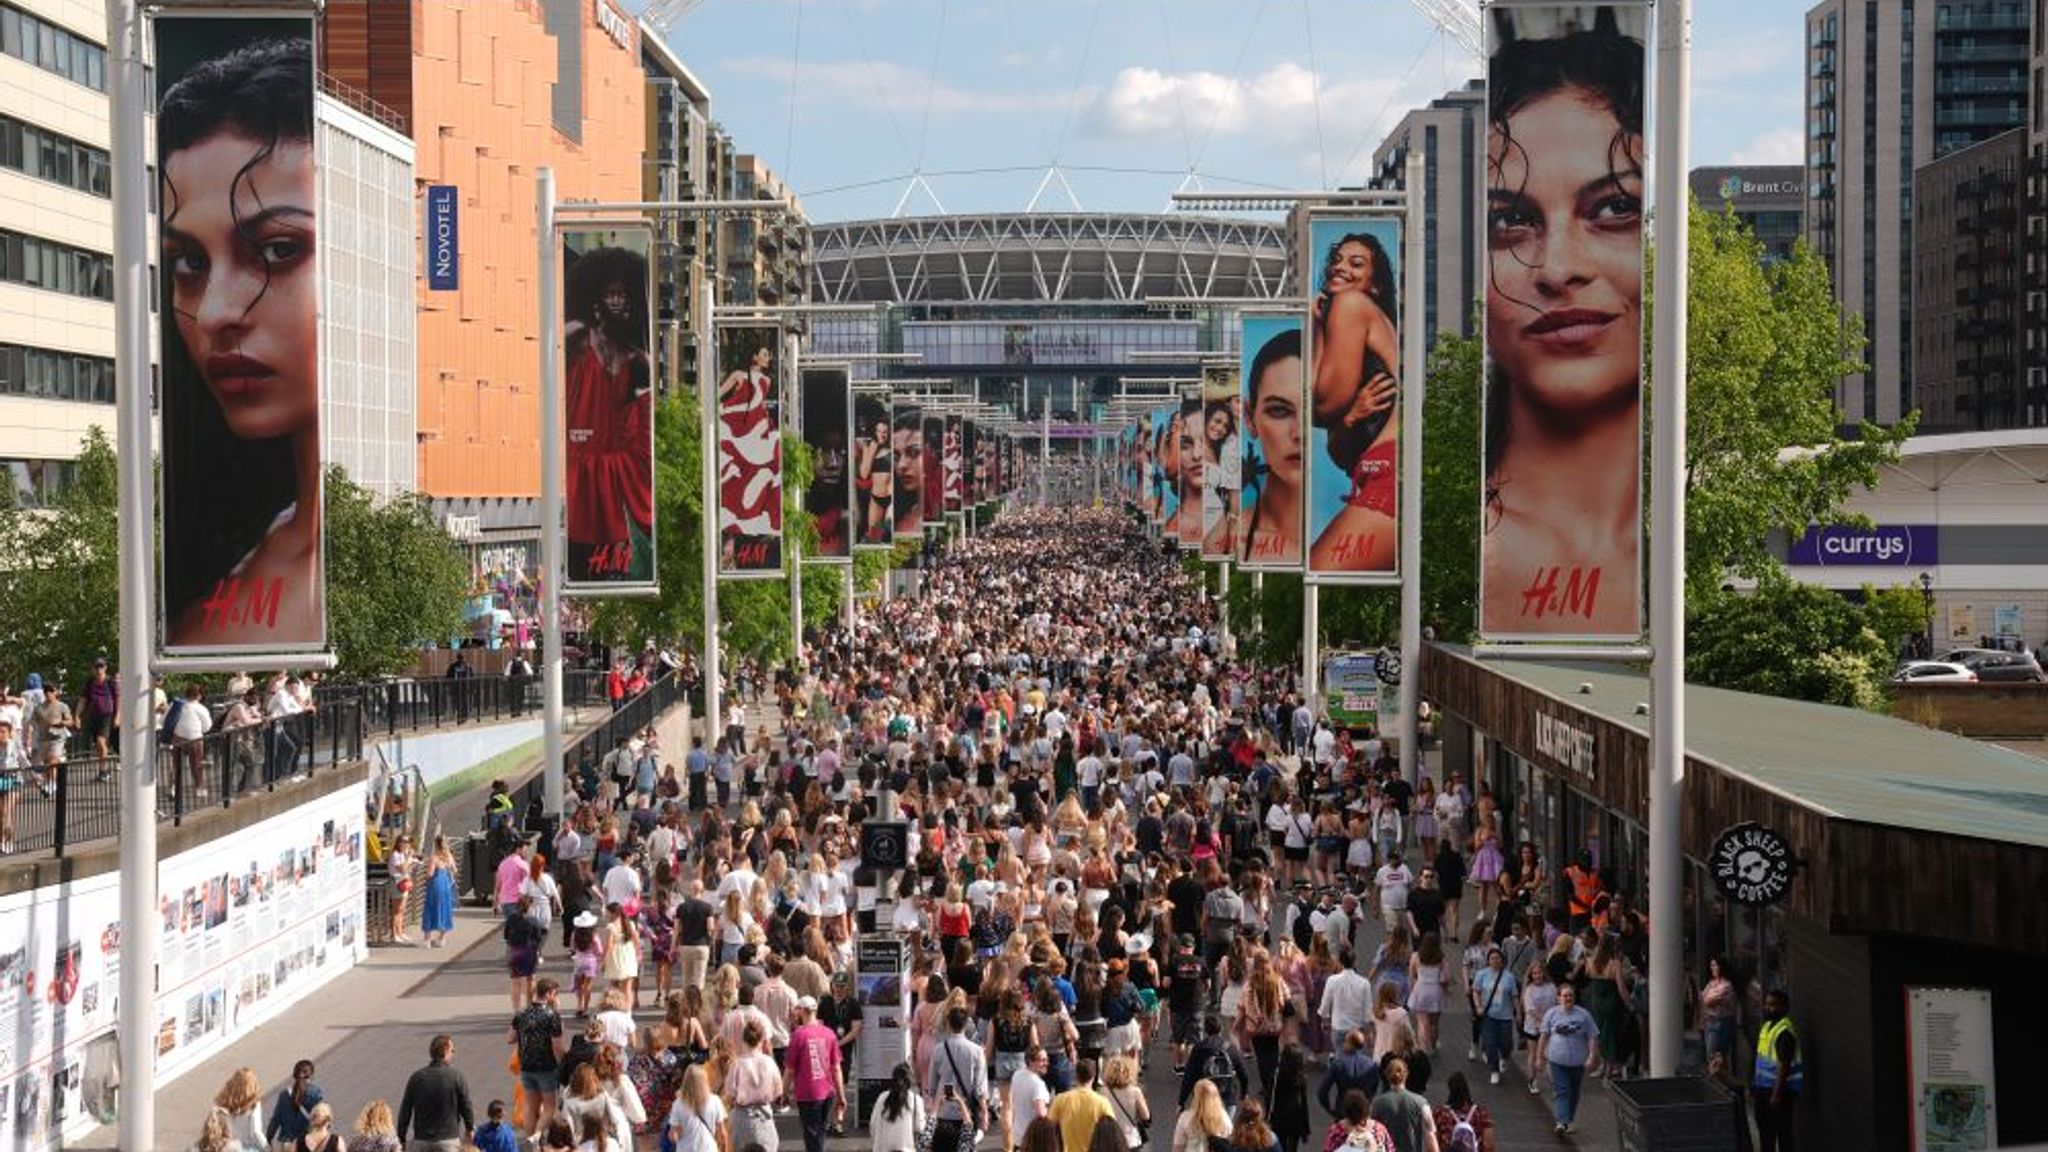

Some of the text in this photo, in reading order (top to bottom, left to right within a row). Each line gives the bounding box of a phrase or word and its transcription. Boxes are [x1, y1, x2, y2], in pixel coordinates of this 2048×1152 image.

[1742, 181, 1780, 193] Brent
[436, 192, 451, 277] NOVOTEL
[588, 543, 634, 574] H&M
[1331, 533, 1376, 563] H&M
[1825, 536, 1904, 560] currys
[203, 576, 283, 634] H&M
[1522, 566, 1602, 620] H&M
[1718, 830, 1785, 877] BLACK SHEEP
[1738, 871, 1788, 901] COFFEE
